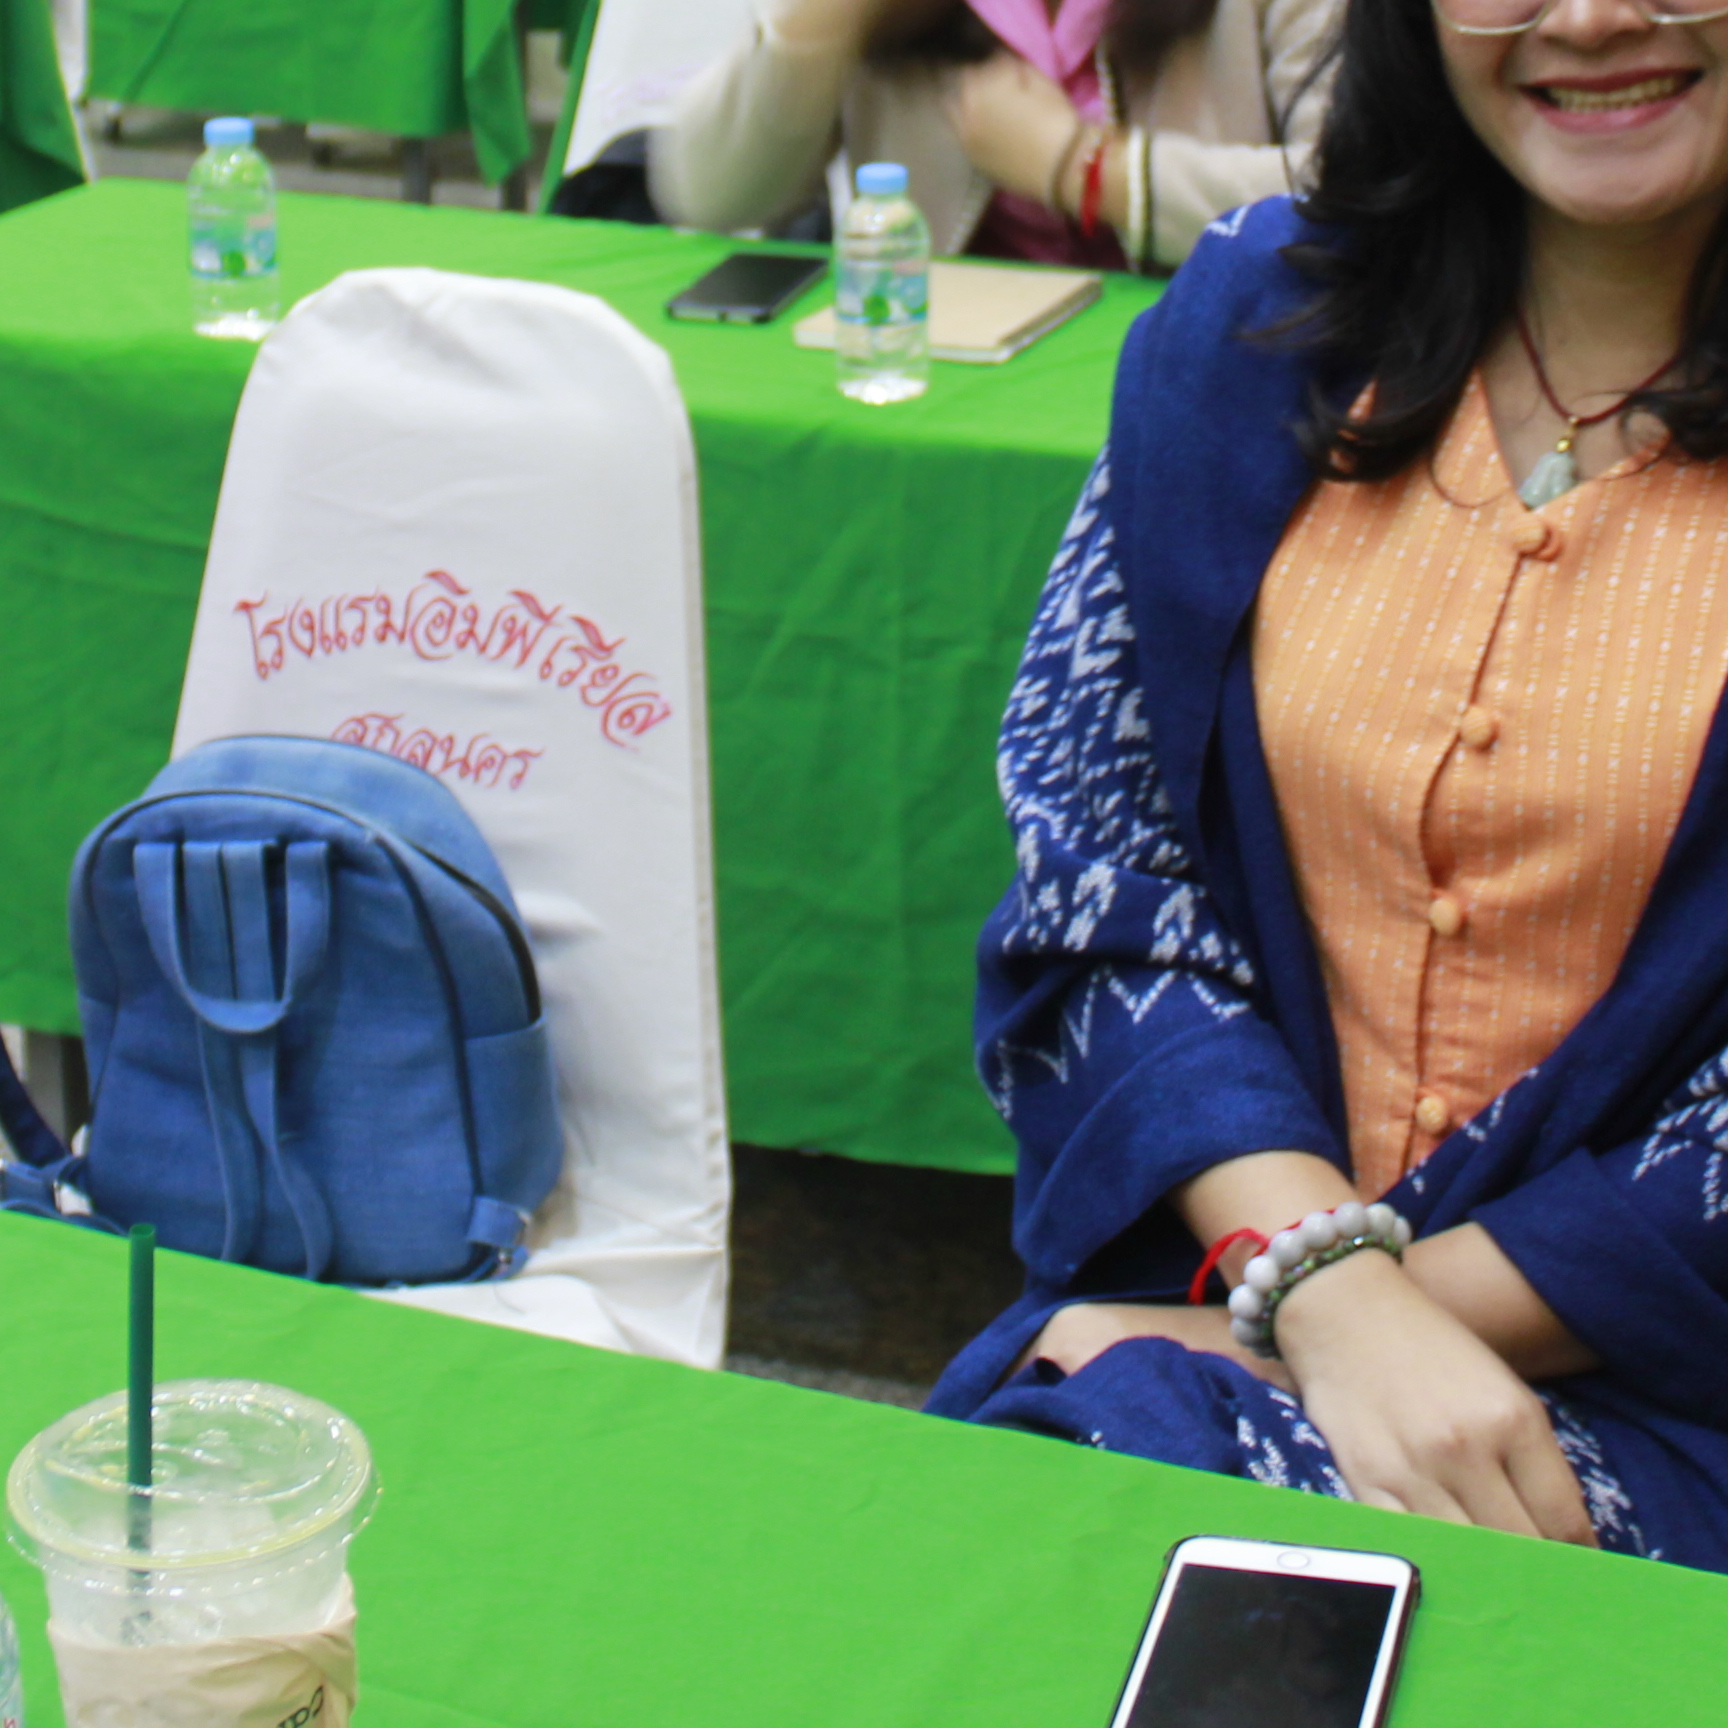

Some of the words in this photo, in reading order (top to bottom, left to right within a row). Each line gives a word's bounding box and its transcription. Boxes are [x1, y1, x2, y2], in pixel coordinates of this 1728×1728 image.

[233, 569, 672, 753] โรงแรมอิมพีเรียล
